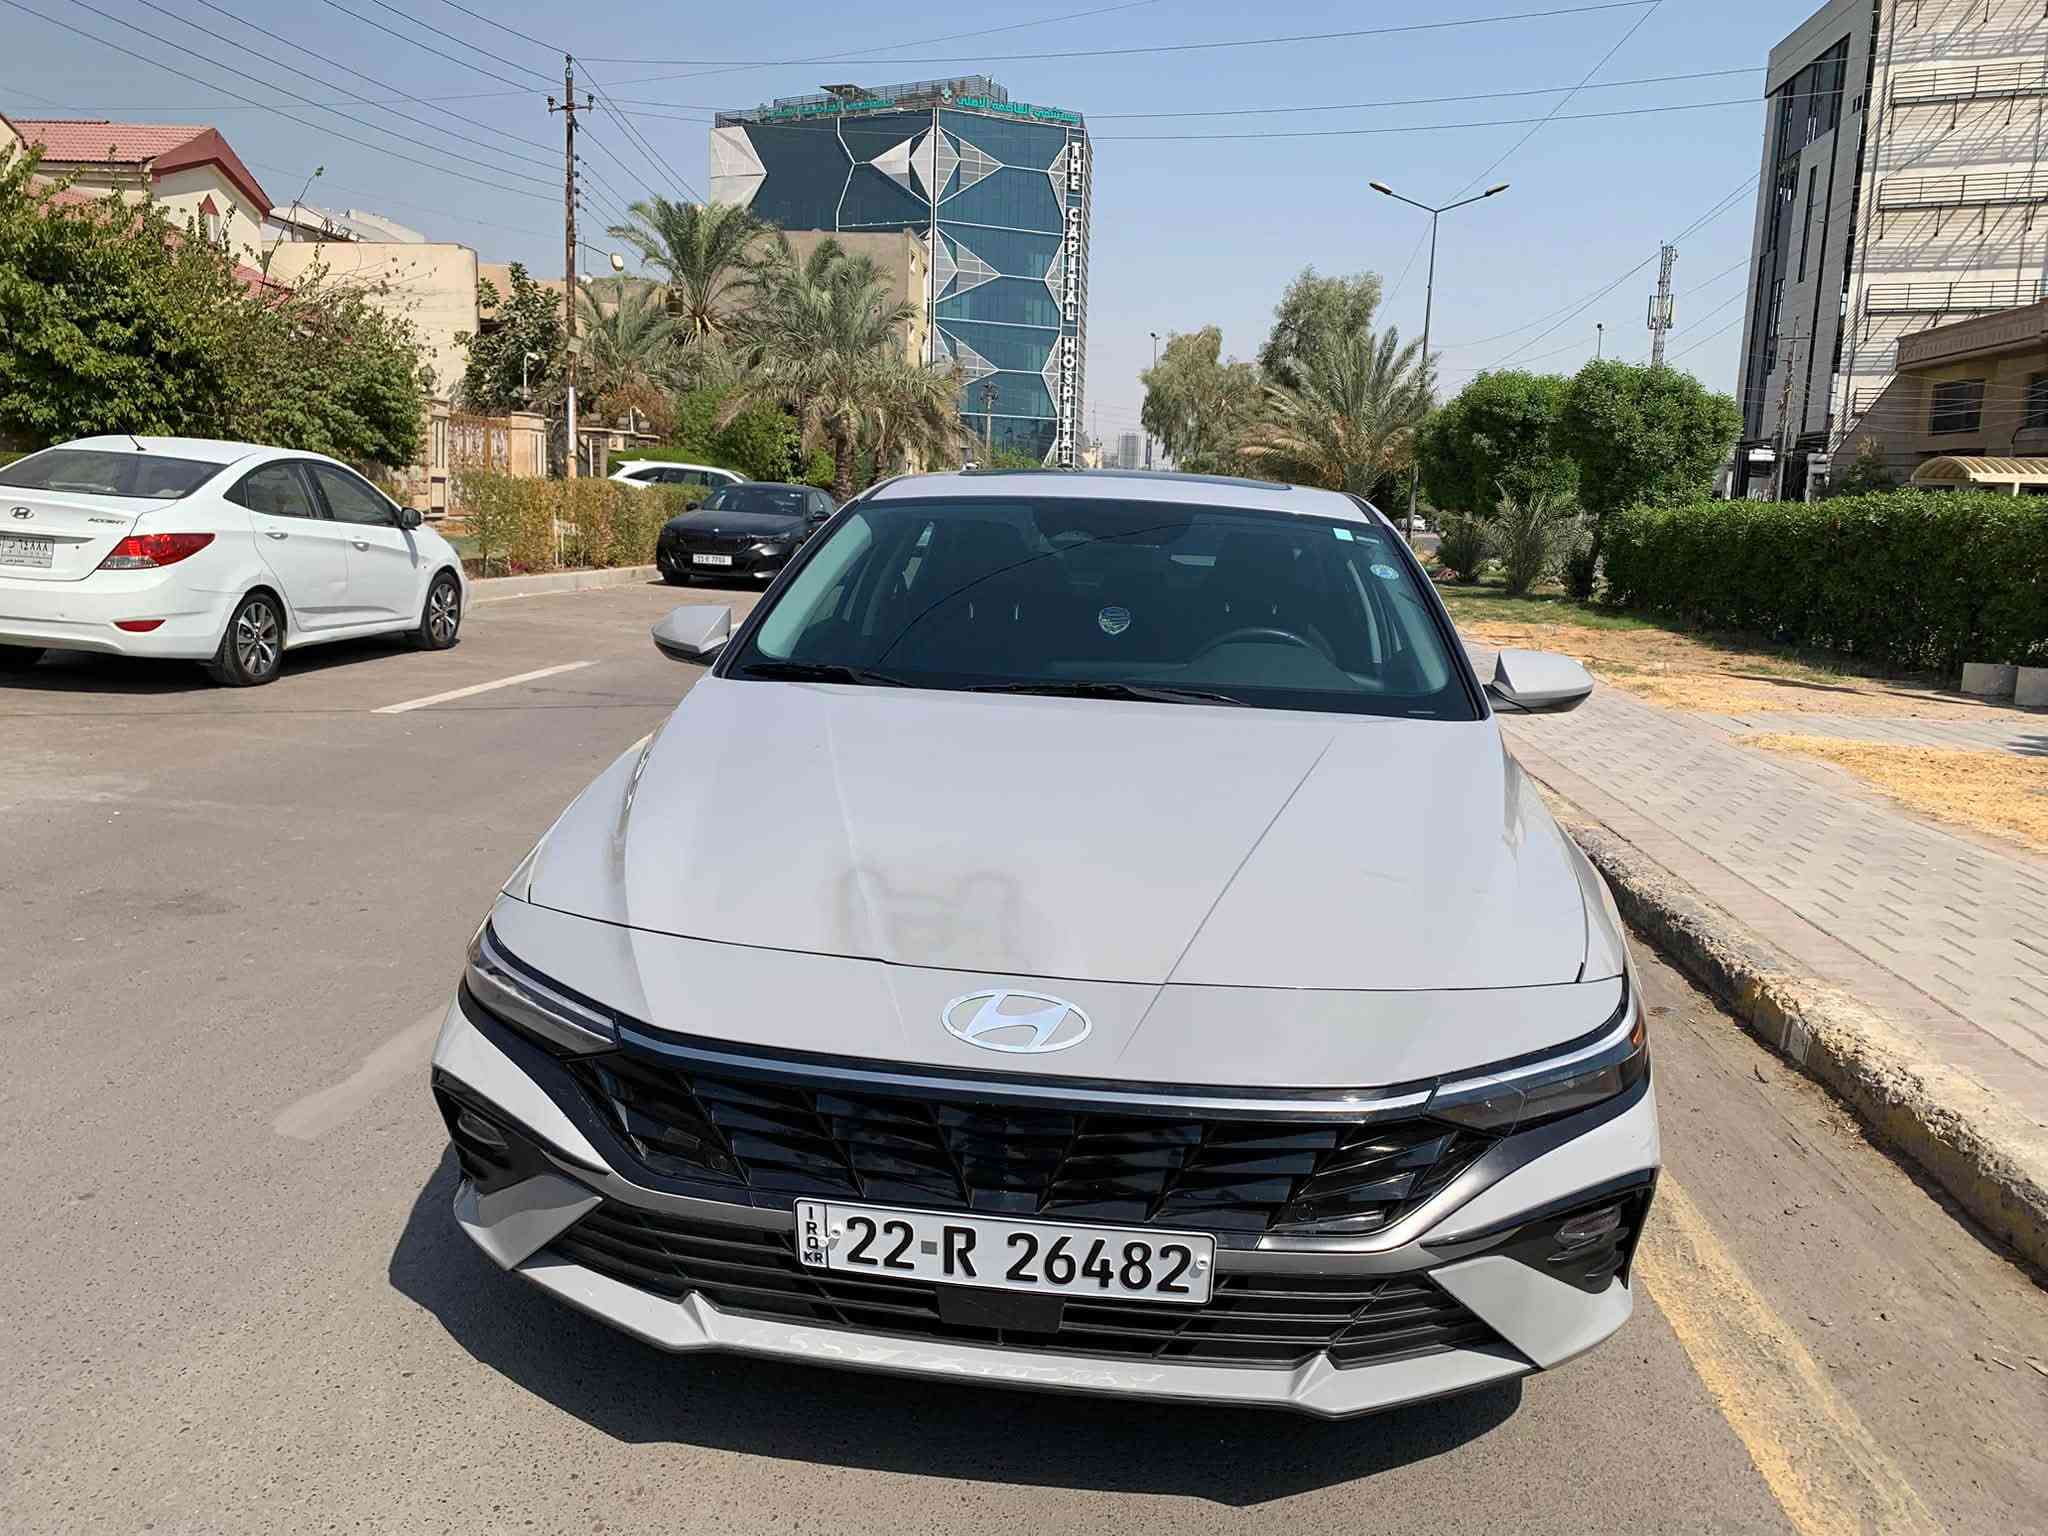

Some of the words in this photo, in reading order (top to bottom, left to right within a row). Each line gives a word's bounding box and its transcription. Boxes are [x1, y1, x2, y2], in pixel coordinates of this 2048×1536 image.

[1070, 142, 1082, 190] THE
[1065, 208, 1079, 321] CAPITAL
[1061, 338, 1075, 464] HOSPITAL
[803, 1250, 825, 1264] KR
[1005, 1232, 1192, 1294] 26482
